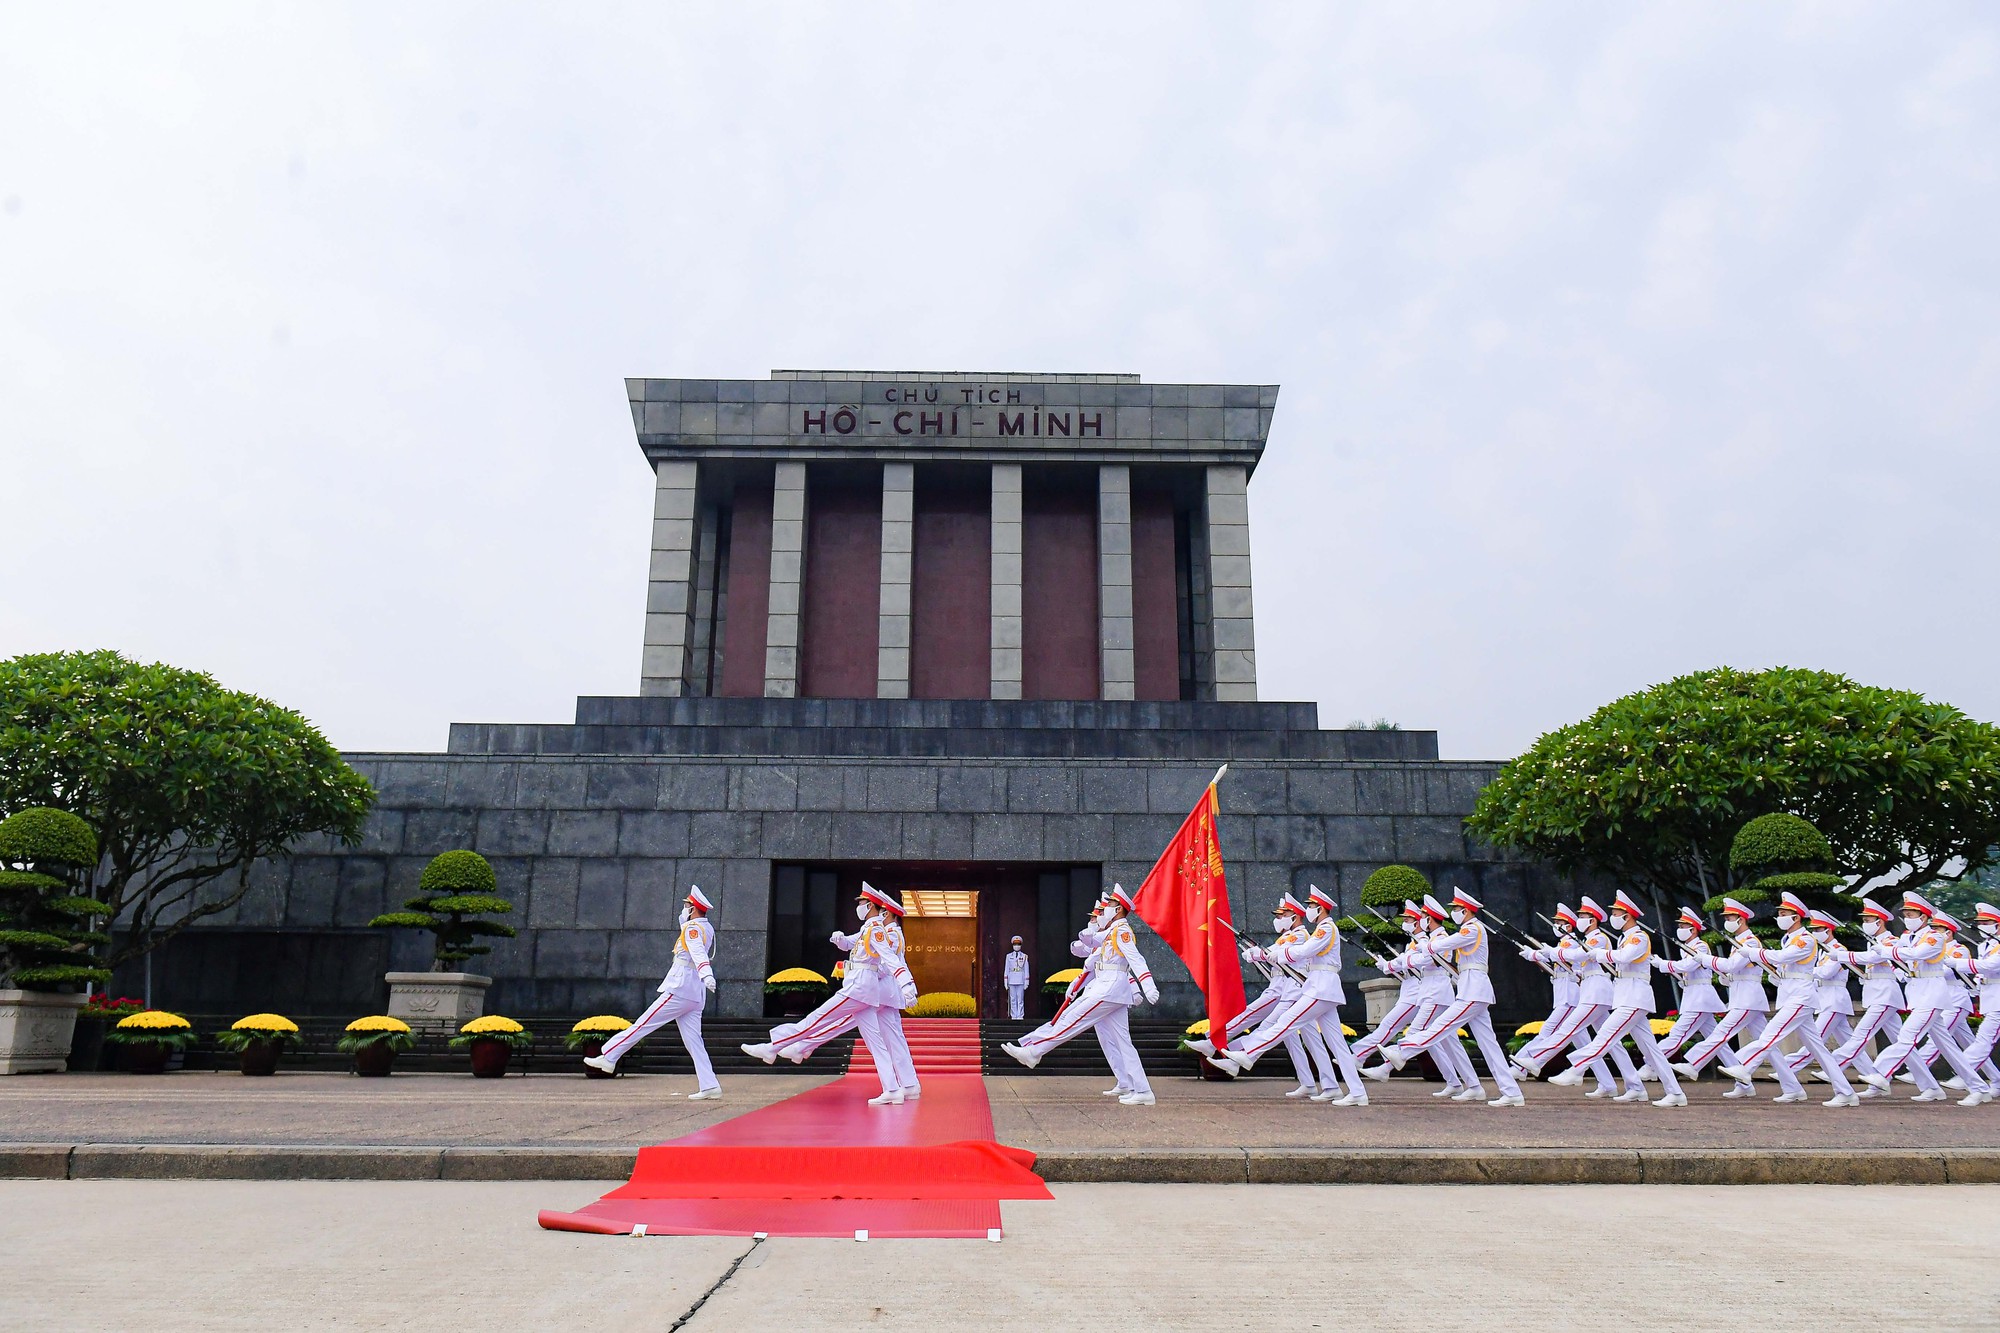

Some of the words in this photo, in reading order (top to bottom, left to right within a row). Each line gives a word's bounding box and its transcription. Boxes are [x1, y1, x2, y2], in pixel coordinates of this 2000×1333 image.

[885, 383, 938, 403] CHỦ
[803, 404, 859, 435] HỒ
[893, 405, 962, 436] CHÍ
